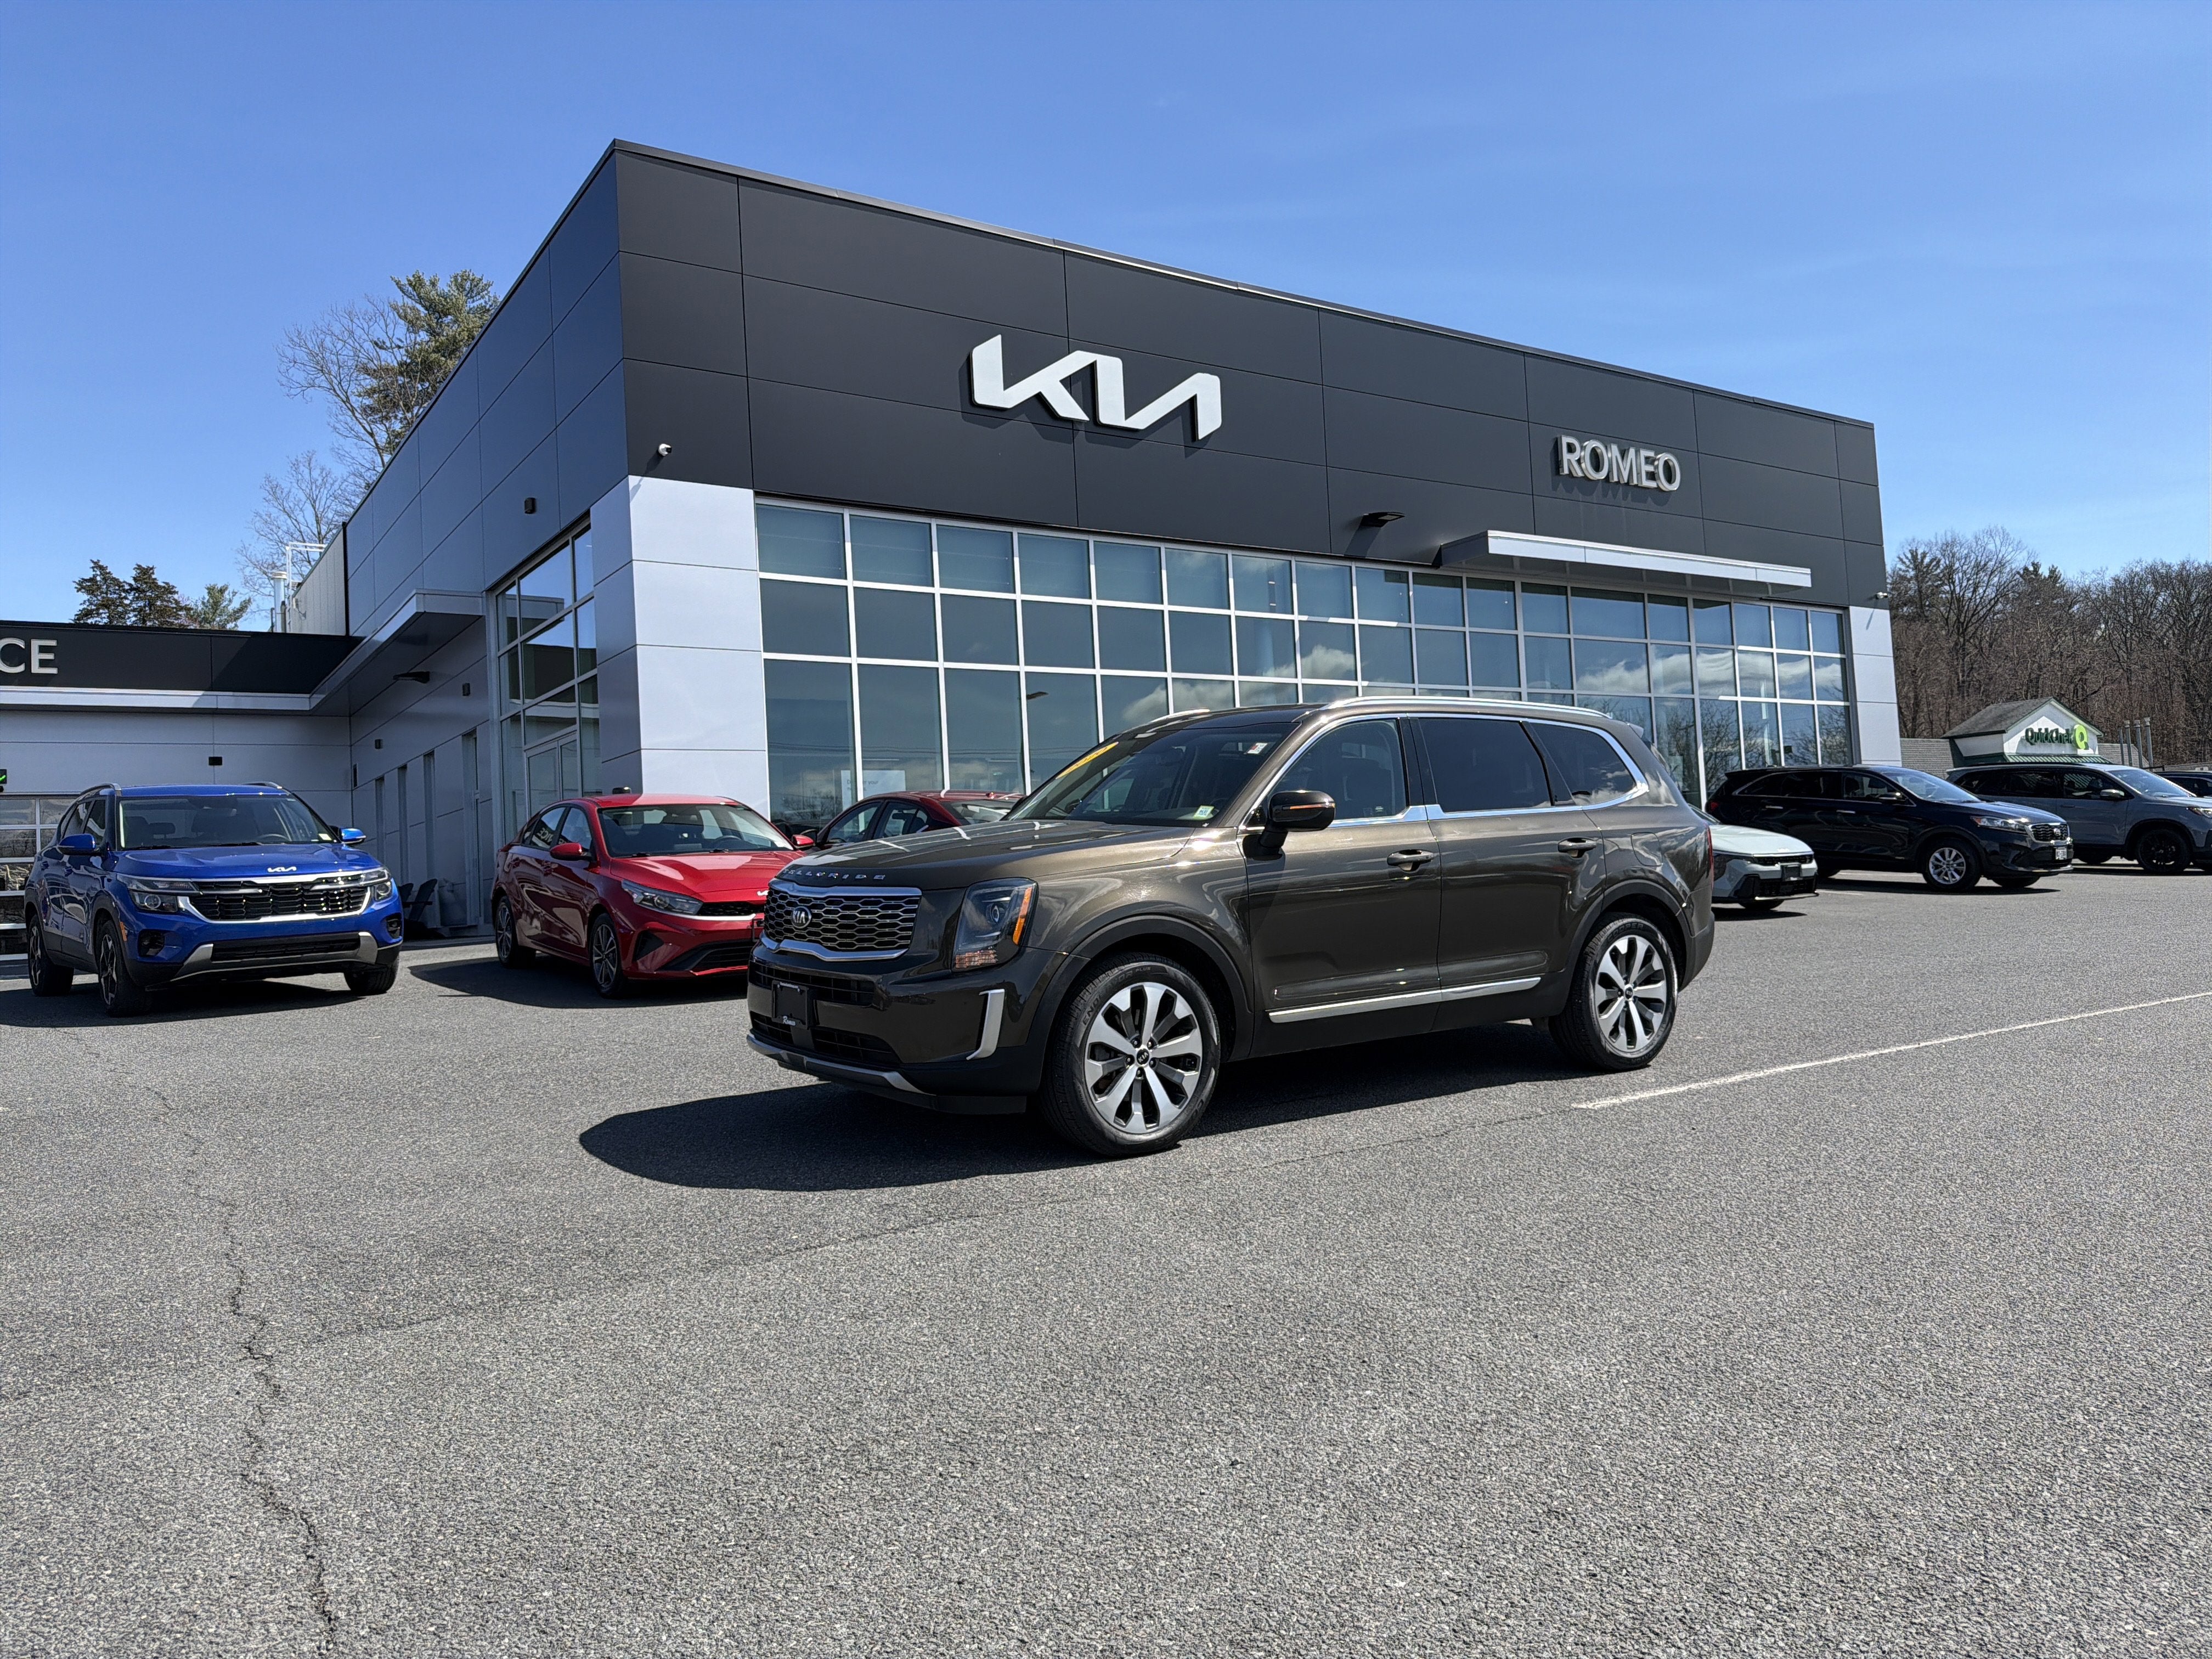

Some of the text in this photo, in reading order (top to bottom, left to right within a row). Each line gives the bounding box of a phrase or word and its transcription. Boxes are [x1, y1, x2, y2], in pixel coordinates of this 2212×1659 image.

[971, 334, 1222, 441] KIA
[1559, 435, 1681, 492] ROMEO
[792, 910, 806, 924] KIA
[1138, 1052, 1149, 1063] KIA
